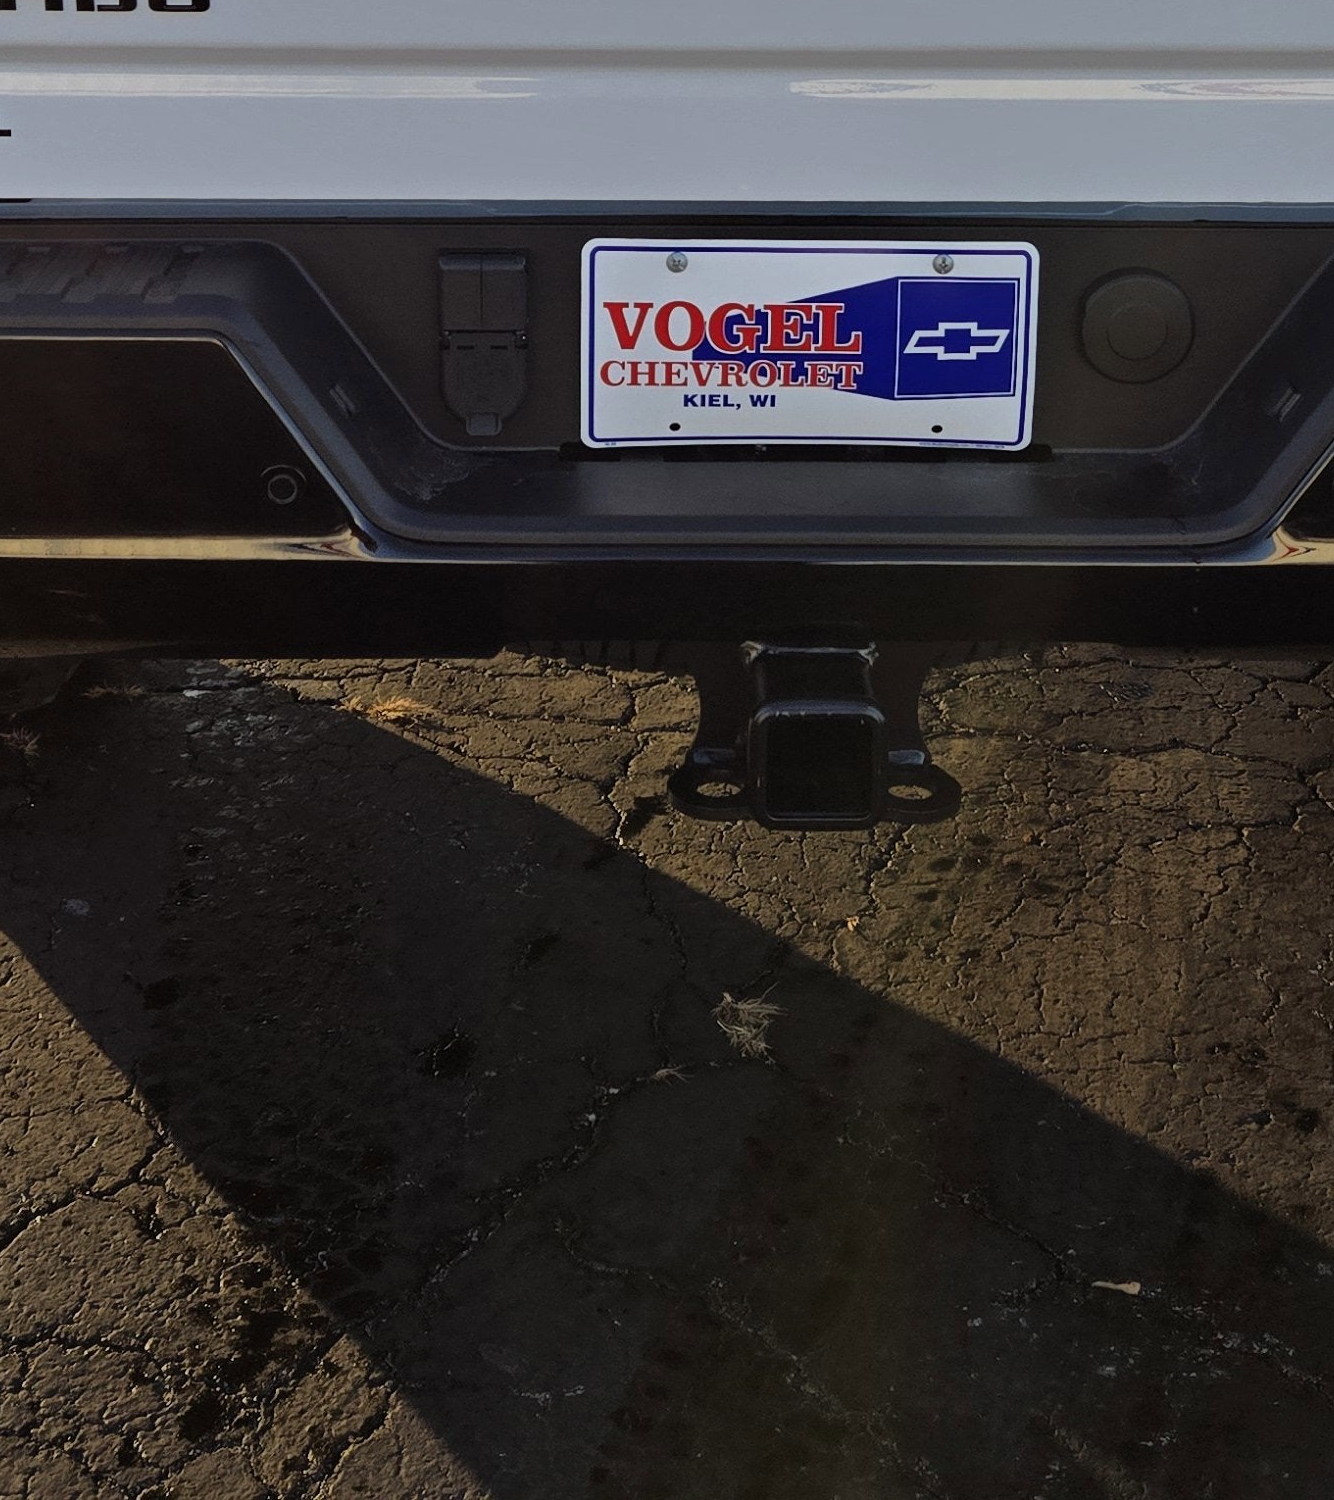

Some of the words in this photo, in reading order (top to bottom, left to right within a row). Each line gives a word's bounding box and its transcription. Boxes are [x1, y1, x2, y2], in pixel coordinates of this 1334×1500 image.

[602, 301, 863, 354] VOGEL
[599, 359, 864, 390] CHEVROLET
[683, 393, 742, 410] KIEL,
[748, 393, 777, 408] WI
